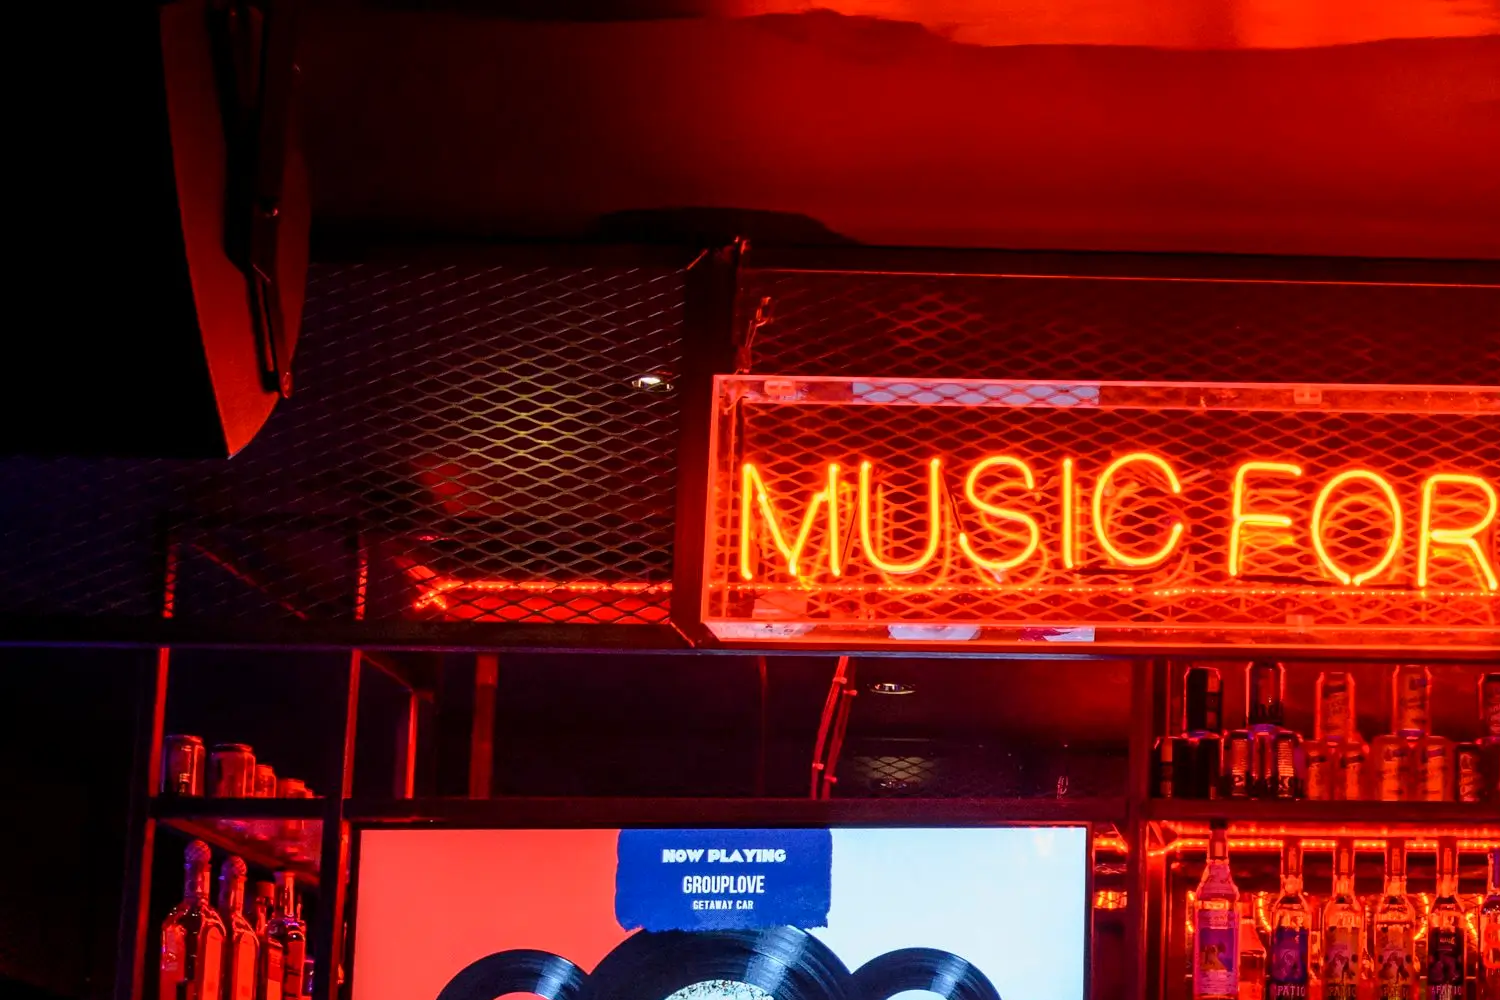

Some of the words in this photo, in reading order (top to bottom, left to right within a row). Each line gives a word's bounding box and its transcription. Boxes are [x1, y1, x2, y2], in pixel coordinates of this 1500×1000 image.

[741, 451, 1182, 579] MUSIC
[1229, 461, 1498, 592] FOR
[662, 849, 704, 863] NOW
[707, 849, 787, 863] PLAYING
[682, 875, 766, 894] GROUPLOVE
[692, 900, 734, 911] GETAWAY
[736, 900, 754, 911] CAR
